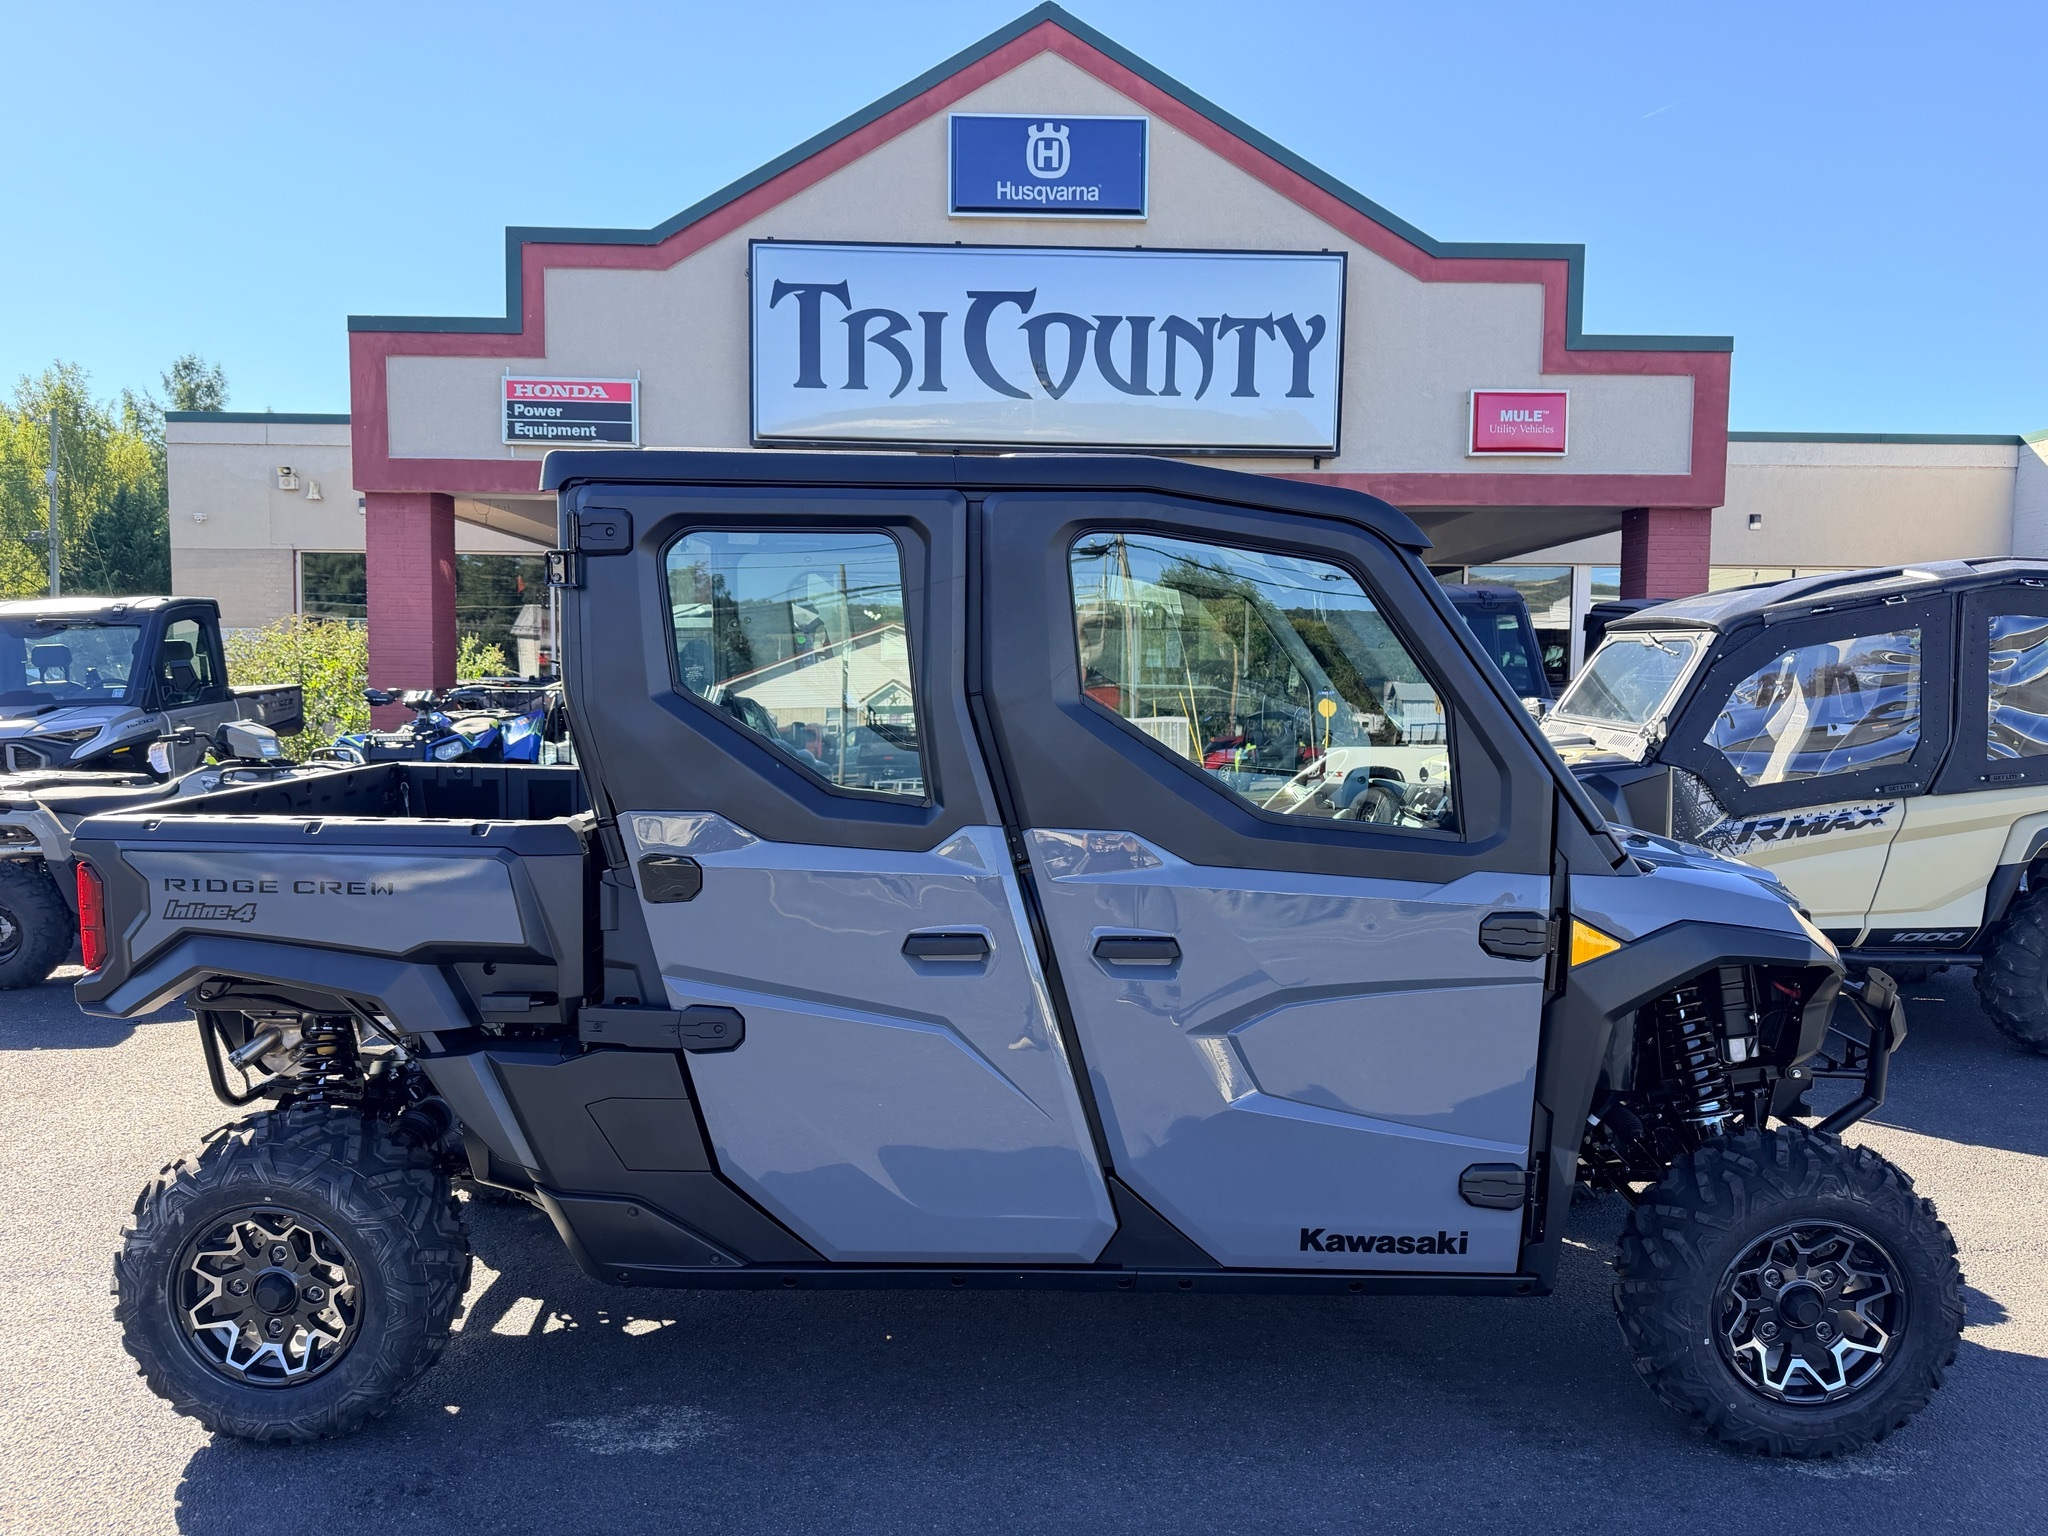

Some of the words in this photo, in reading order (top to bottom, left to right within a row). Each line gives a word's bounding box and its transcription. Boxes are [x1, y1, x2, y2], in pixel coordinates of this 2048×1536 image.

[996, 181, 1099, 204] Husqvarna
[513, 383, 609, 398] HONDA
[513, 403, 563, 417] Power
[514, 422, 597, 438] Equipment
[1489, 424, 1517, 435] Utility
[1519, 424, 1554, 434] Vehicles
[1793, 801, 1895, 819] WOLVERINE
[164, 878, 279, 894] RIDGE
[293, 880, 394, 896] CREW
[162, 899, 257, 923] Inline-4
[1889, 931, 1967, 943] 1000
[1300, 1228, 1468, 1255] Kawasaki
